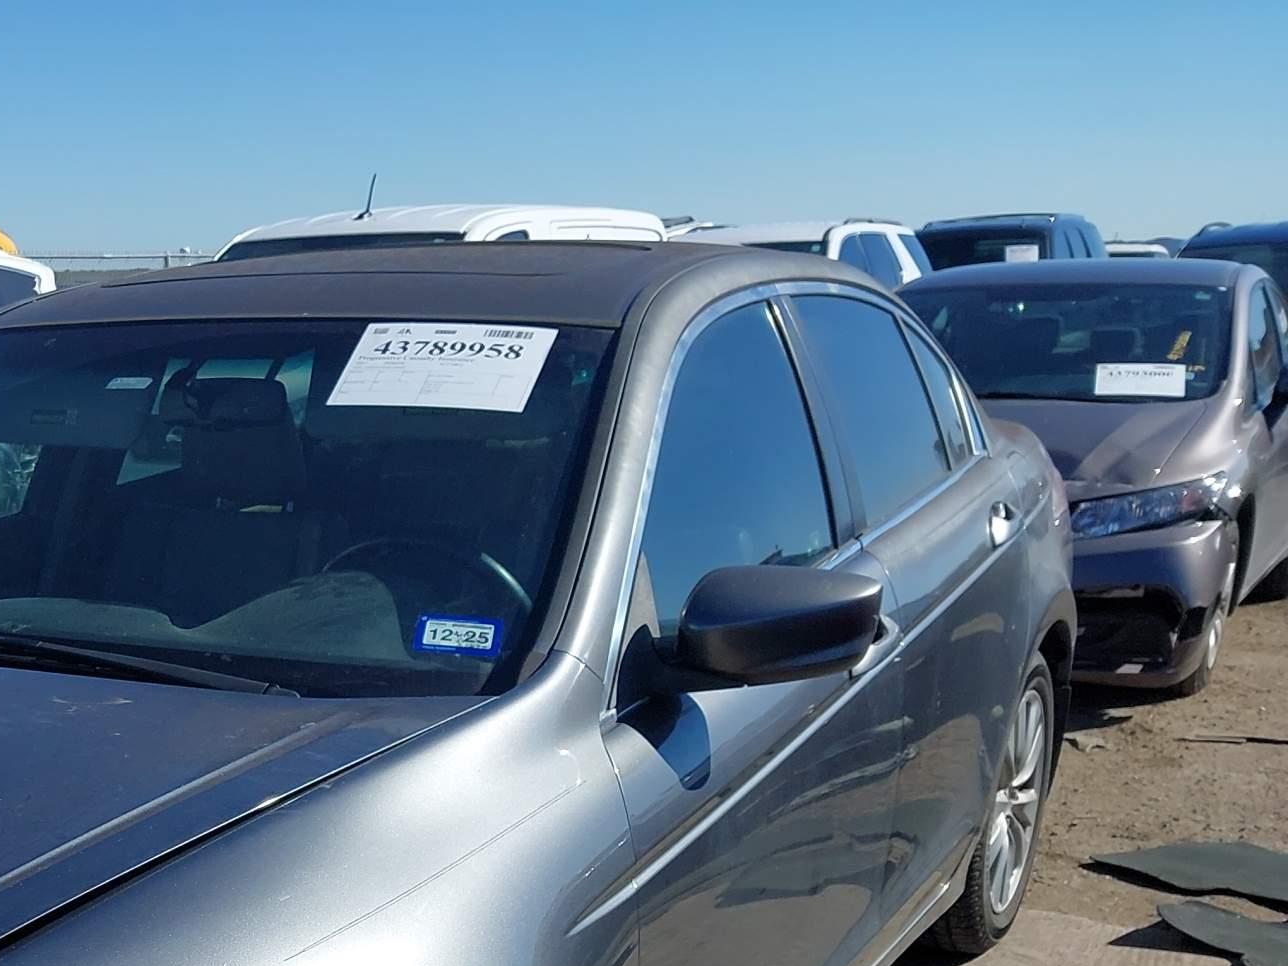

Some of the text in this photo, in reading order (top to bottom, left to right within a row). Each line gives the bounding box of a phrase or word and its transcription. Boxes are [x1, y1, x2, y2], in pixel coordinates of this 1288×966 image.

[373, 339, 525, 361] 43789958
[430, 628, 491, 645] 12 25
